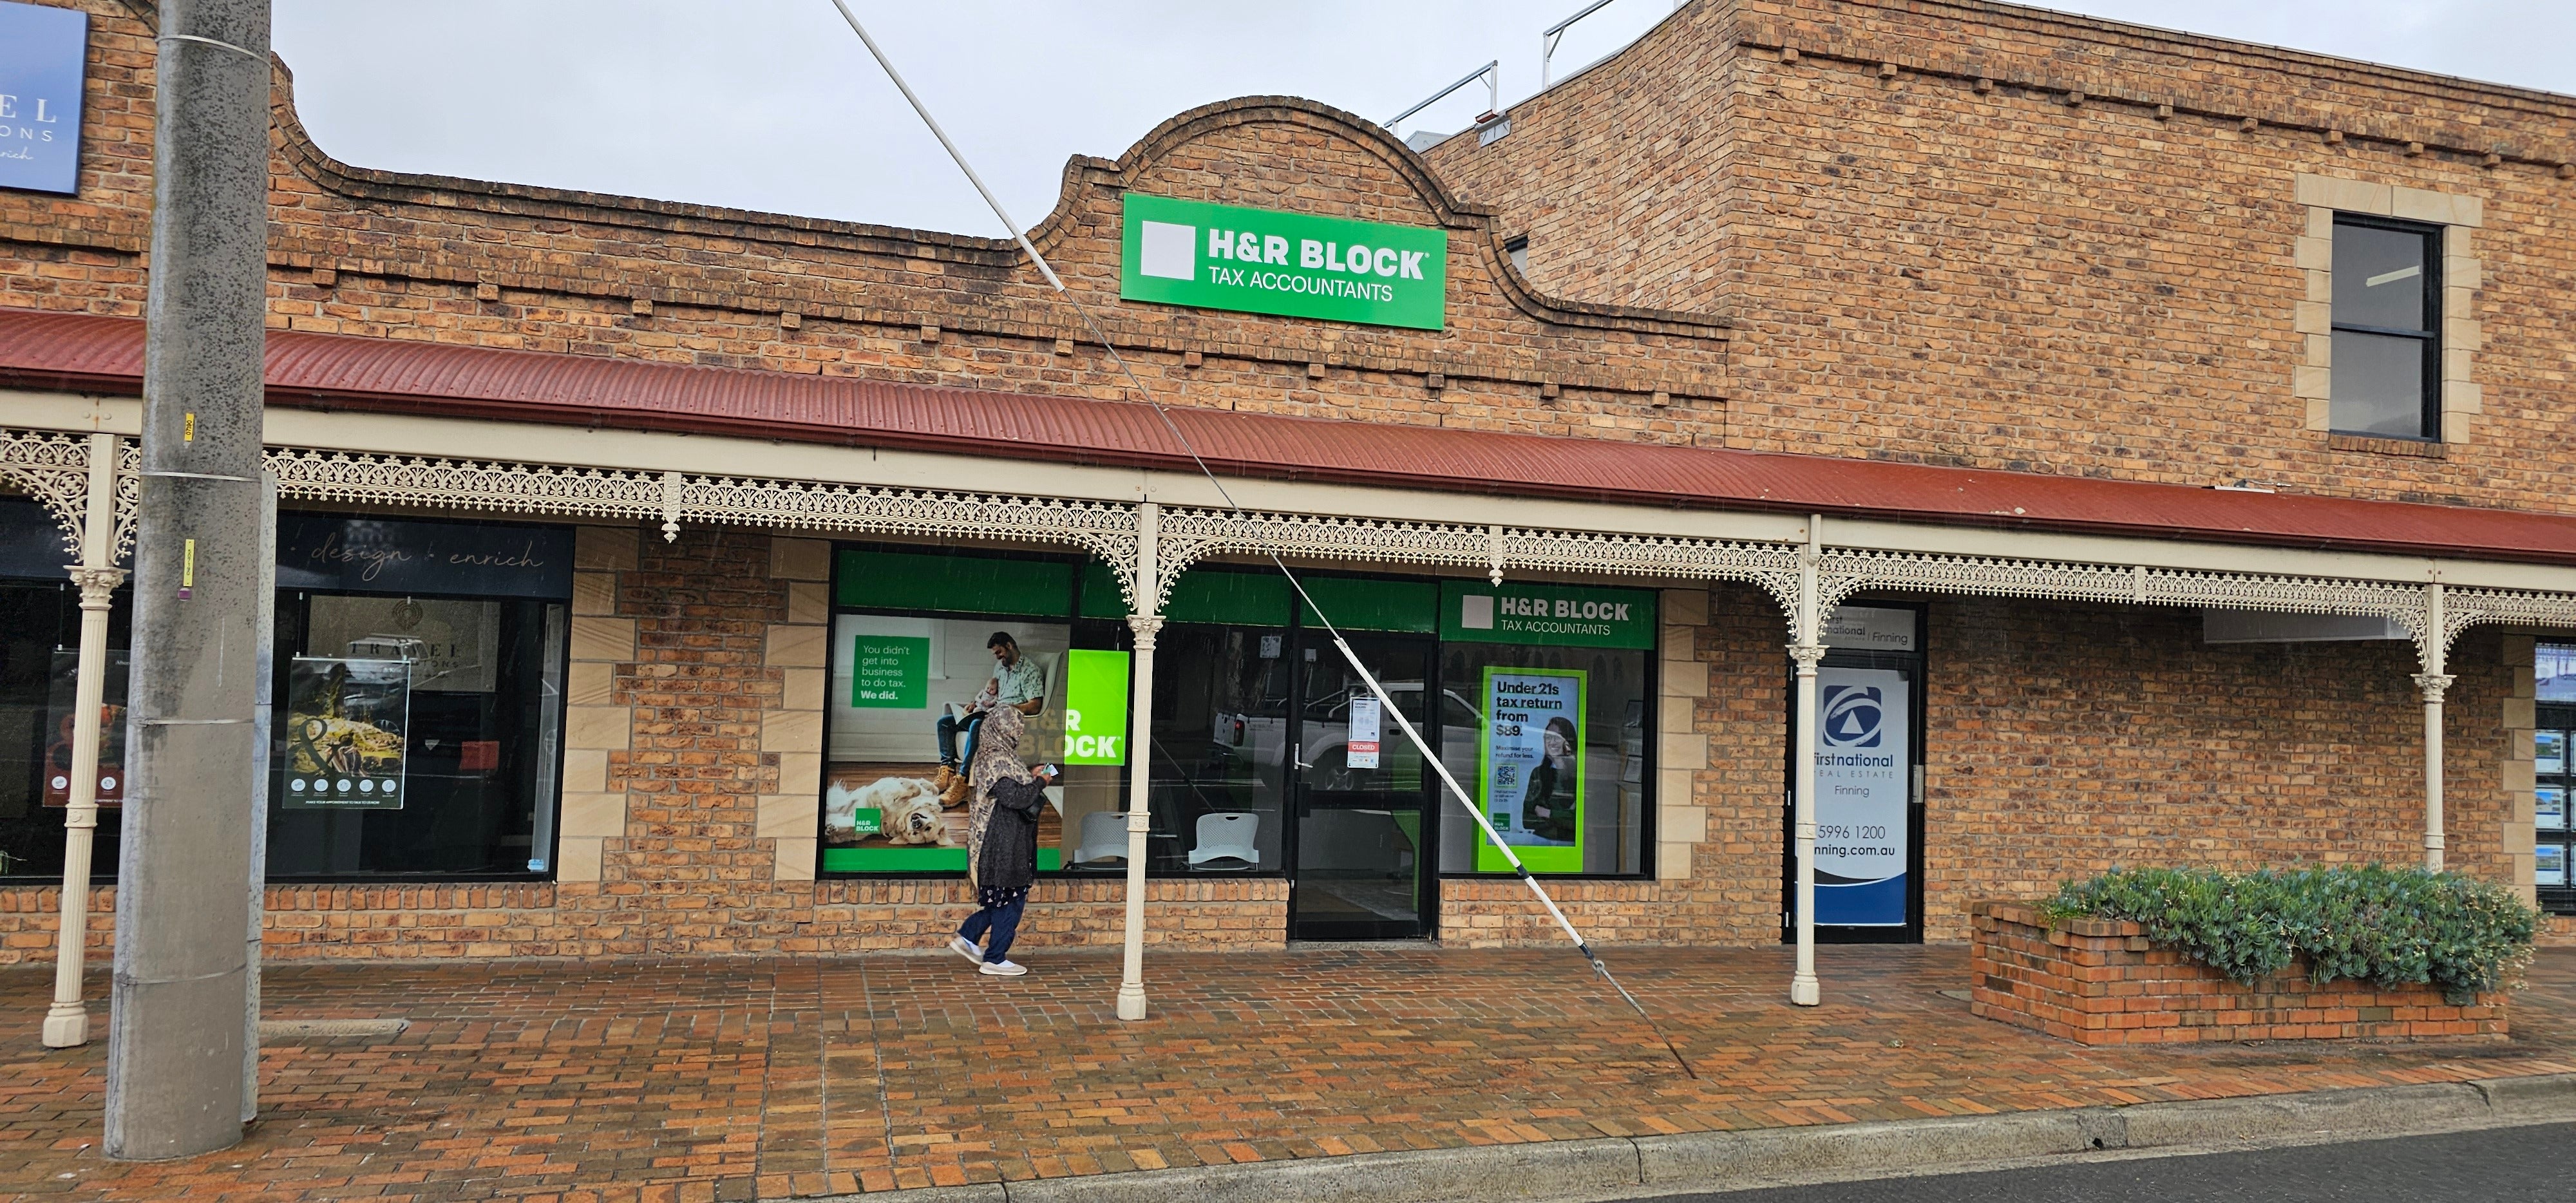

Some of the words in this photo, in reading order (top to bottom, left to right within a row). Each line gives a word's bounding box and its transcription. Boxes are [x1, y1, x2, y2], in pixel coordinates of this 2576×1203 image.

[1208, 228, 1289, 266] H&R
[1209, 266, 1245, 287] TAX
[1250, 270, 1393, 302] ACCOUNTANTS
[311, 533, 412, 581] design
[450, 540, 544, 567] enrich
[1501, 597, 1548, 617] H&R
[1501, 620, 1522, 631] TAX
[1525, 621, 1611, 636] ACCOUNTANTS
[1827, 625, 1866, 635] national
[1873, 632, 1908, 645] Finning
[864, 645, 880, 654] You
[883, 645, 910, 655] didn't
[862, 657, 878, 666] get
[880, 657, 898, 665] into
[862, 667, 903, 676] business
[873, 678, 886, 687] do
[1497, 681, 1537, 694] Under
[1539, 683, 1560, 695] 21s
[860, 690, 877, 699] We
[878, 690, 898, 700] did.
[1496, 696, 1519, 708] tax
[1520, 698, 1562, 709] return
[1496, 709, 1528, 722] from
[1496, 724, 1523, 737] $89.
[1850, 770, 1893, 779] ESTATE
[1835, 785, 1870, 798] Finning
[1818, 825, 1850, 838] 5996
[1855, 826, 1886, 839] 1200
